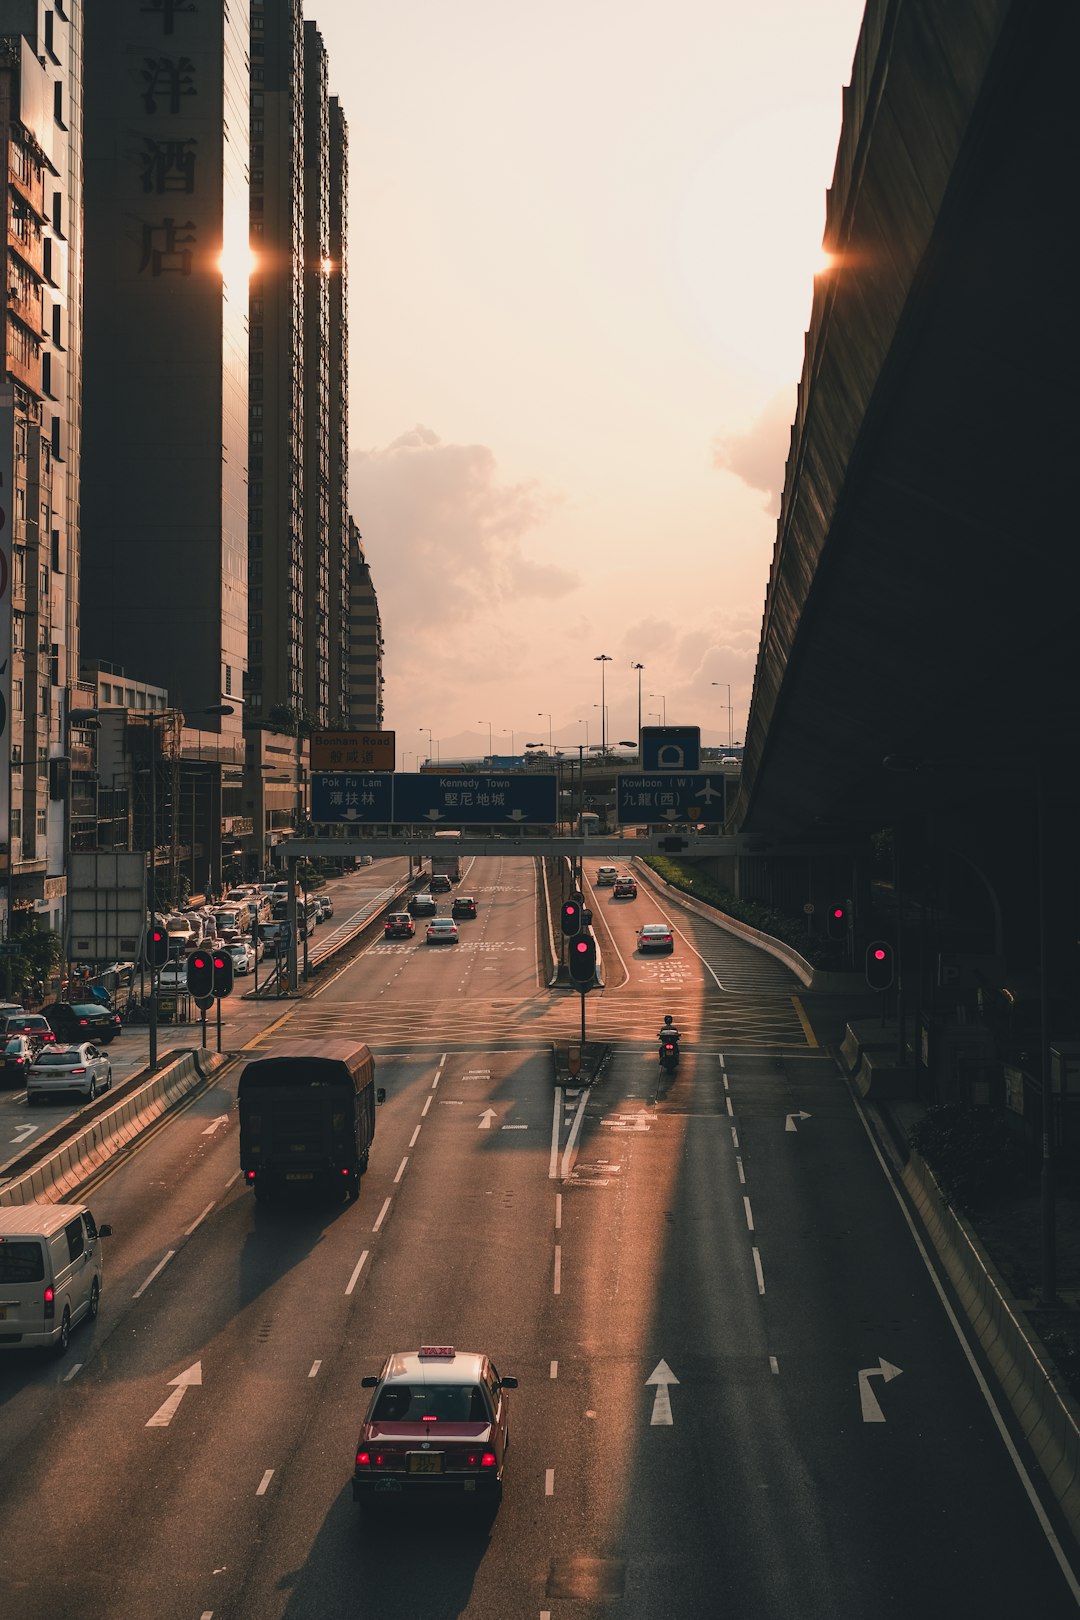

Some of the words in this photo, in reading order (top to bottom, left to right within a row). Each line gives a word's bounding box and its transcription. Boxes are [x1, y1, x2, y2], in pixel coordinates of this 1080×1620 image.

[315, 736, 357, 746] Bonham
[363, 736, 390, 746] Road
[330, 749, 374, 764] 般咸道
[321, 777, 340, 787] Pok
[345, 777, 357, 787] Fu
[362, 777, 382, 787] Lam
[439, 778, 480, 790] Kennedy
[485, 778, 510, 788] Town
[622, 777, 662, 788] Kowloon
[330, 791, 376, 806] 薄扶林
[444, 792, 505, 806] 堅尼地城
[623, 791, 680, 807] 九龍(西)
[422, 1347, 452, 1355] TAXI
